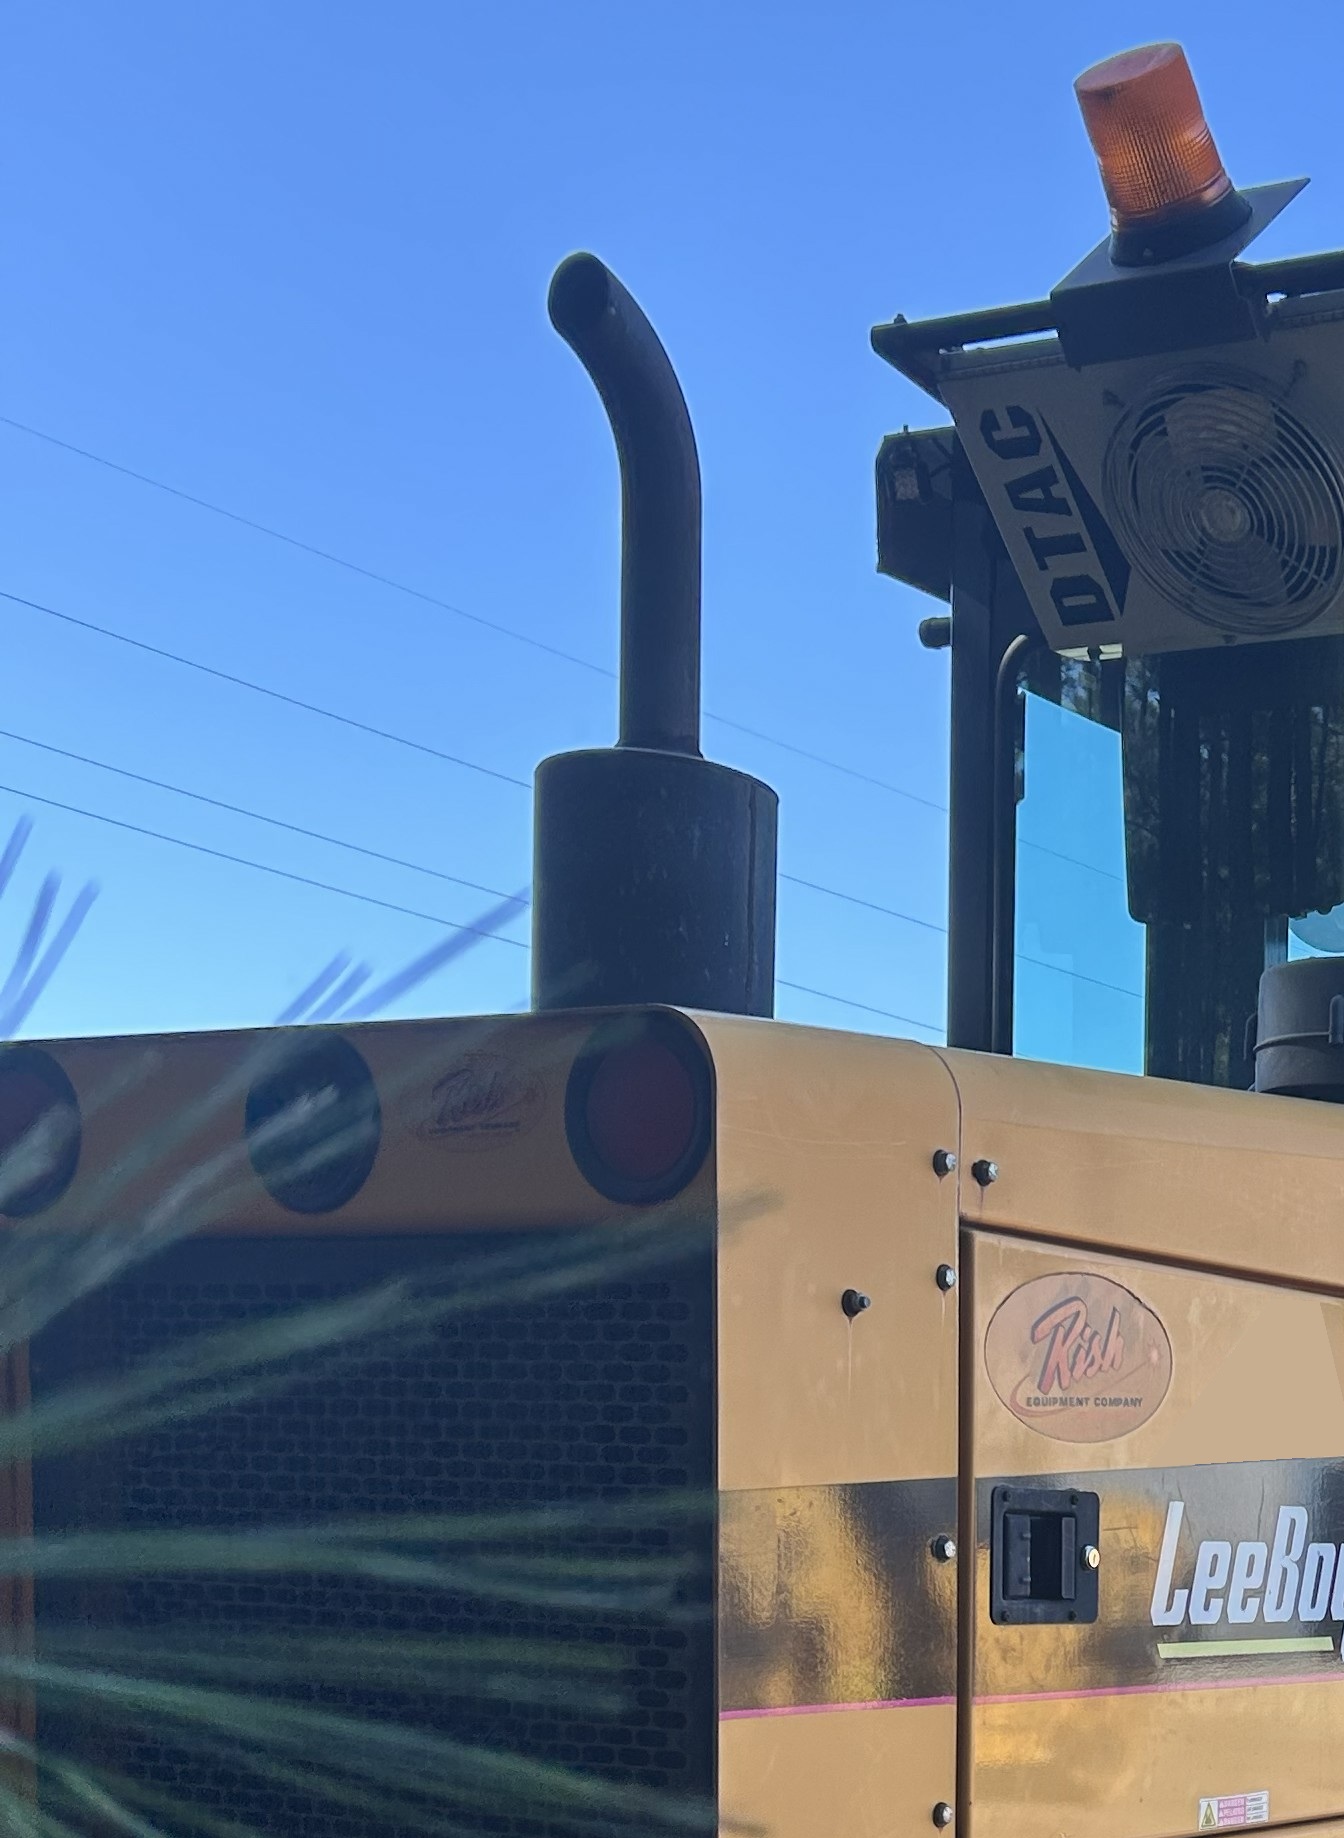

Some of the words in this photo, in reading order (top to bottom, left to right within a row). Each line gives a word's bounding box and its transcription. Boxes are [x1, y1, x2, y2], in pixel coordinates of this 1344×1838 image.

[980, 404, 1116, 627] DTAC
[1030, 1295, 1124, 1396] Rish
[1026, 1396, 1091, 1408] EQUIPMENT
[1093, 1396, 1144, 1408] COMPANY
